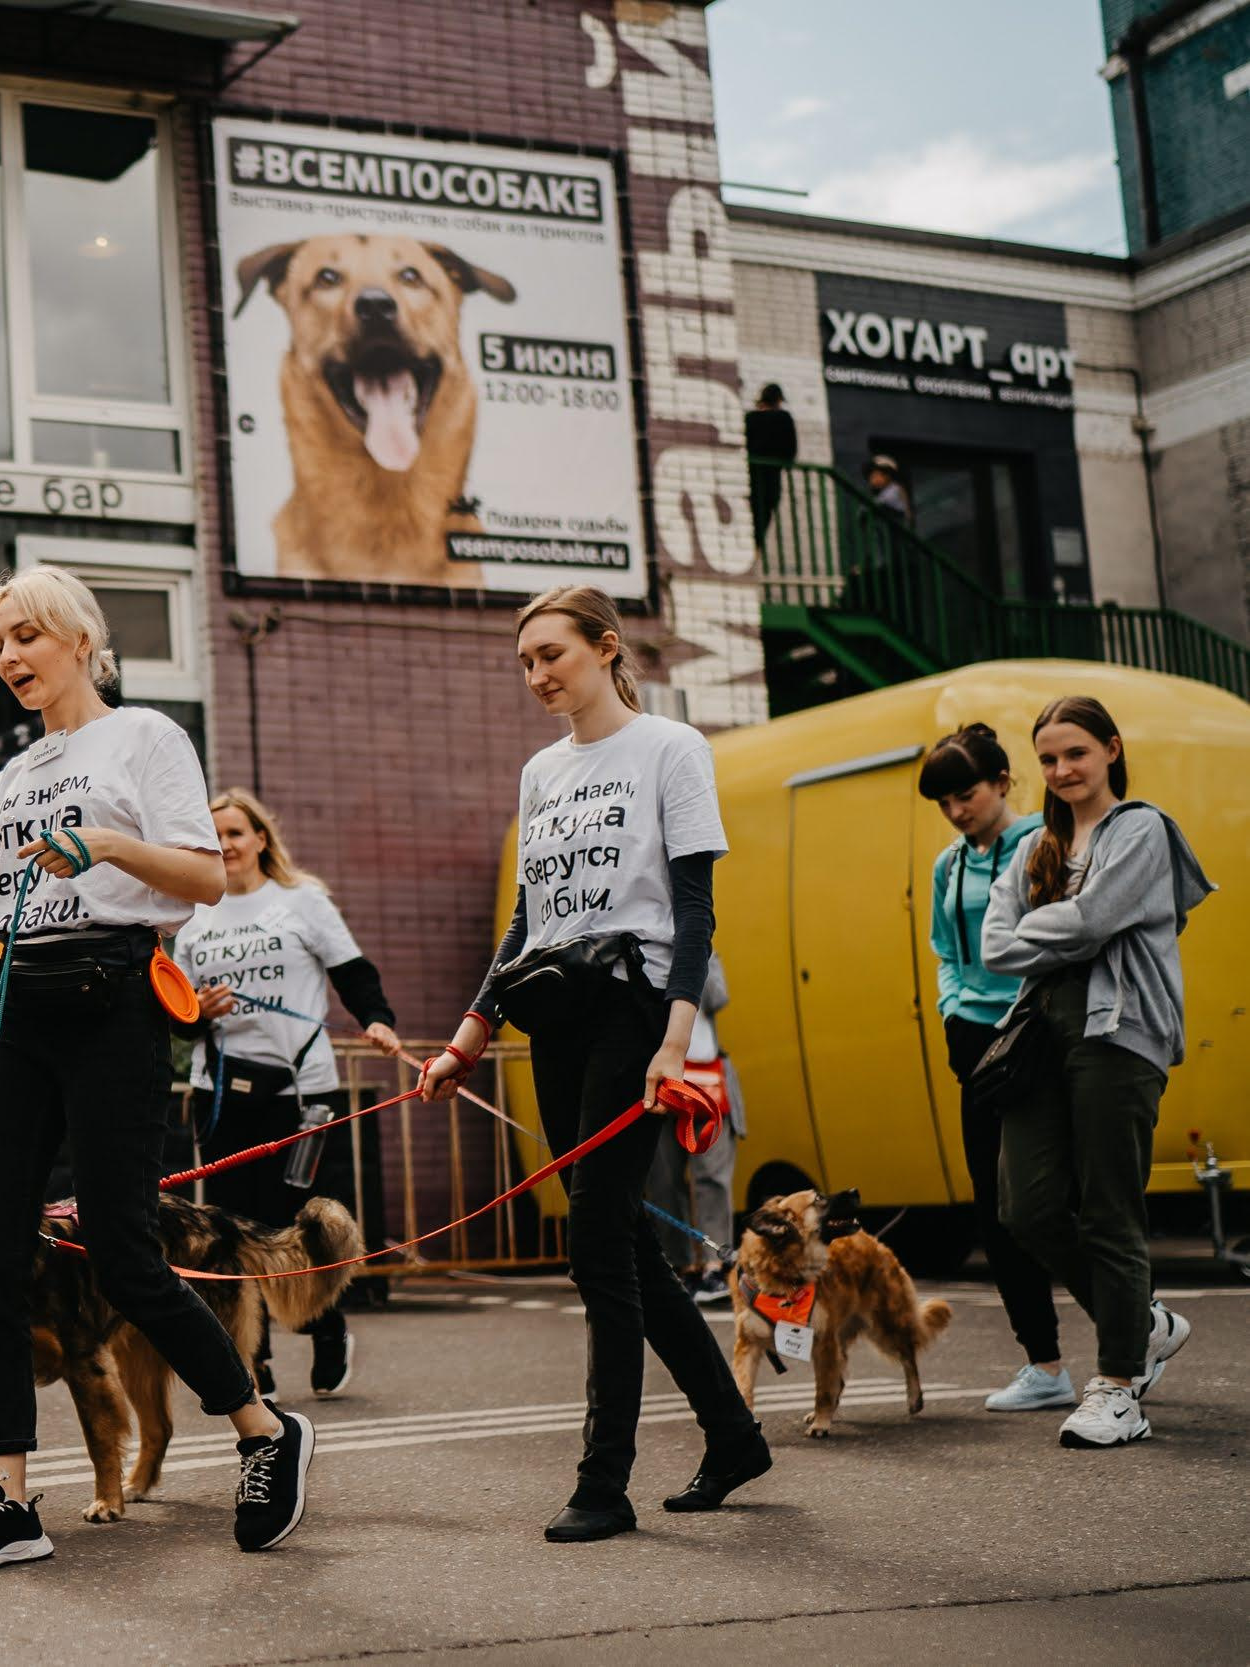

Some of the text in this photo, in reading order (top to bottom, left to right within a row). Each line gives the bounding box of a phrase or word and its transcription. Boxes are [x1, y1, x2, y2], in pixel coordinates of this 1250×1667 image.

[232, 144, 600, 218] #ВСЕМПОСОБАКЕ
[484, 335, 506, 370] 5
[825, 307, 1080, 388] ХОГАРТ_арт
[43, 477, 124, 517] бар
[450, 536, 626, 567] vsemposobake.ru
[523, 845, 621, 885] берутся
[195, 936, 283, 967] откуда
